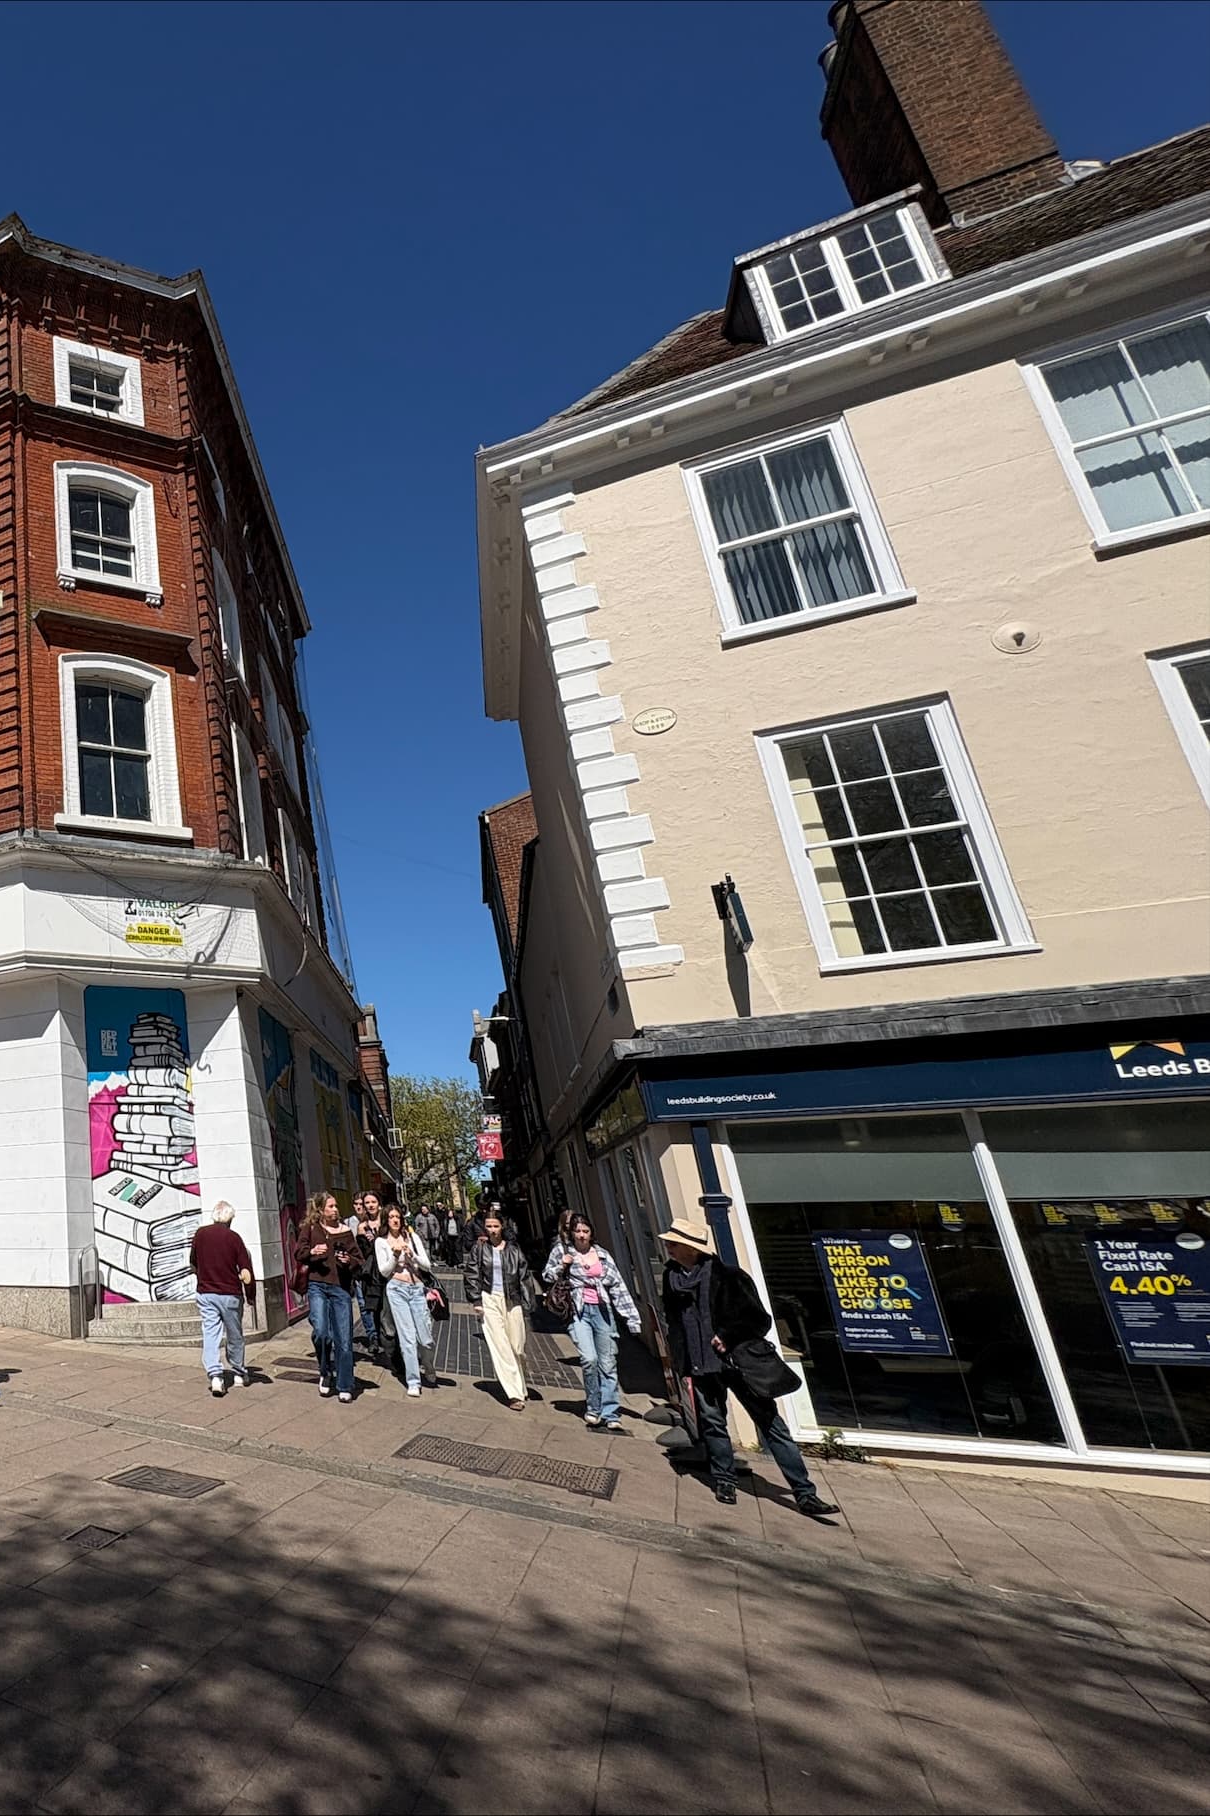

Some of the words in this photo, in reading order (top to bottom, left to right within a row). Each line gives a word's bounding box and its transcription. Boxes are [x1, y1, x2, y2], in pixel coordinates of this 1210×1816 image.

[137, 926, 170, 935] DANGER
[1115, 1060, 1192, 1078] Leeds
[667, 1092, 776, 1105] leedsbuildingsociety.co.uk
[823, 1245, 862, 1256] THAT
[1094, 1240, 1104, 1249] 1
[1105, 1240, 1139, 1250] Year
[827, 1255, 890, 1266] PERSON
[1098, 1250, 1137, 1261] Fixed
[1139, 1250, 1174, 1261] Rate
[830, 1266, 868, 1277] WHO
[1102, 1261, 1139, 1272] Cash
[1140, 1261, 1168, 1272] ISA
[833, 1277, 878, 1288] LIKES
[879, 1275, 907, 1289] TO
[1109, 1274, 1192, 1296] 4.40%
[837, 1287, 877, 1298] PICK
[879, 1287, 890, 1299] &
[840, 1298, 913, 1310] CHOOSE
[841, 1311, 863, 1319] finds
[871, 1312, 892, 1320] cash
